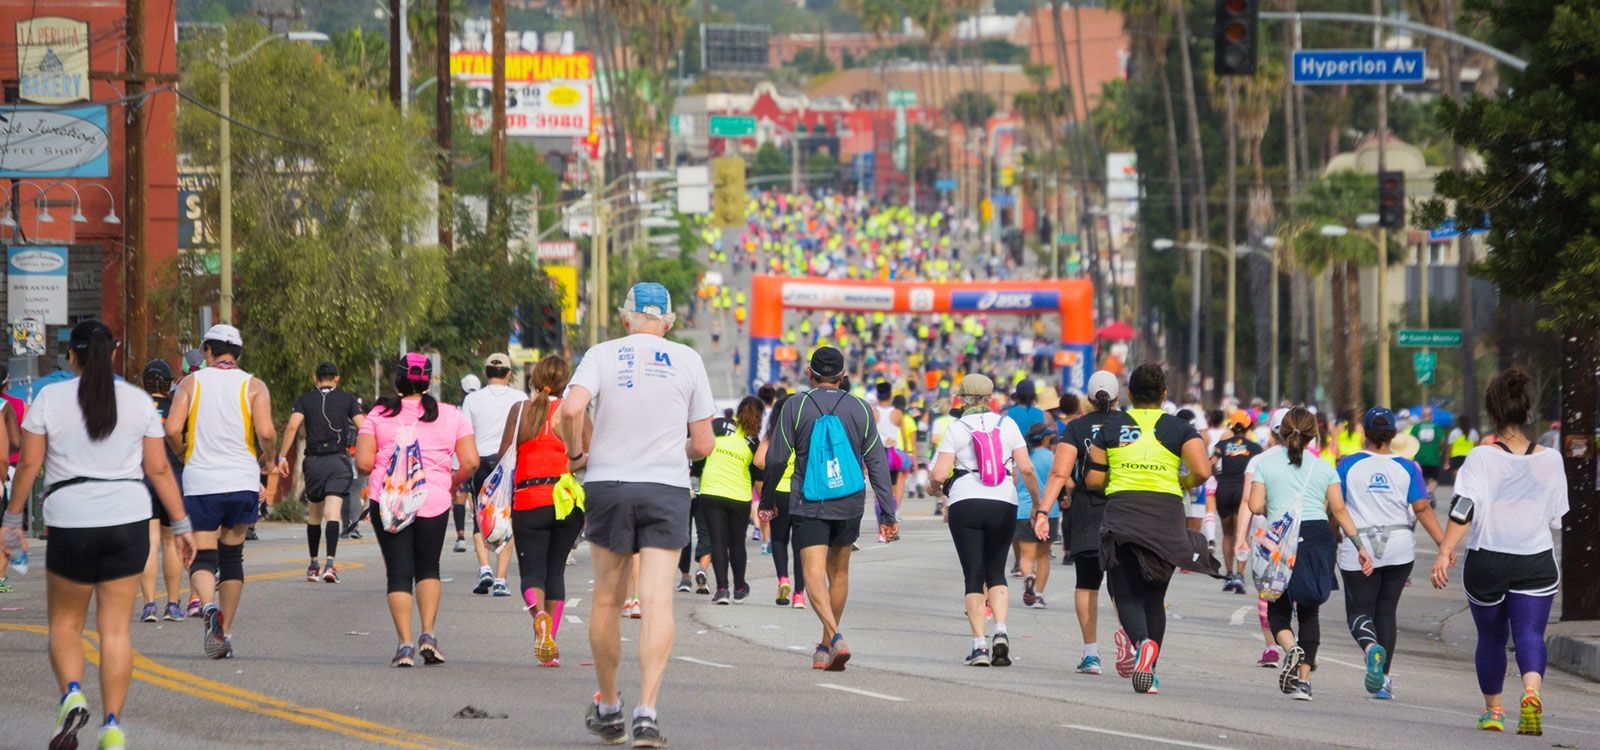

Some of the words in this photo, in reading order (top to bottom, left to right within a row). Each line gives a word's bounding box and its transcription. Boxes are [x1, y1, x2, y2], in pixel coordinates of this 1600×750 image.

[20, 24, 33, 46] LA
[504, 53, 589, 80] MPLANTS
[1301, 56, 1387, 78] Hyperion
[1393, 57, 1417, 74] Av
[21, 73, 82, 97] BAKERY
[28, 119, 96, 144] Junction
[655, 351, 672, 366] LA
[716, 448, 746, 463] HONDA
[1121, 463, 1167, 472] HONDA
